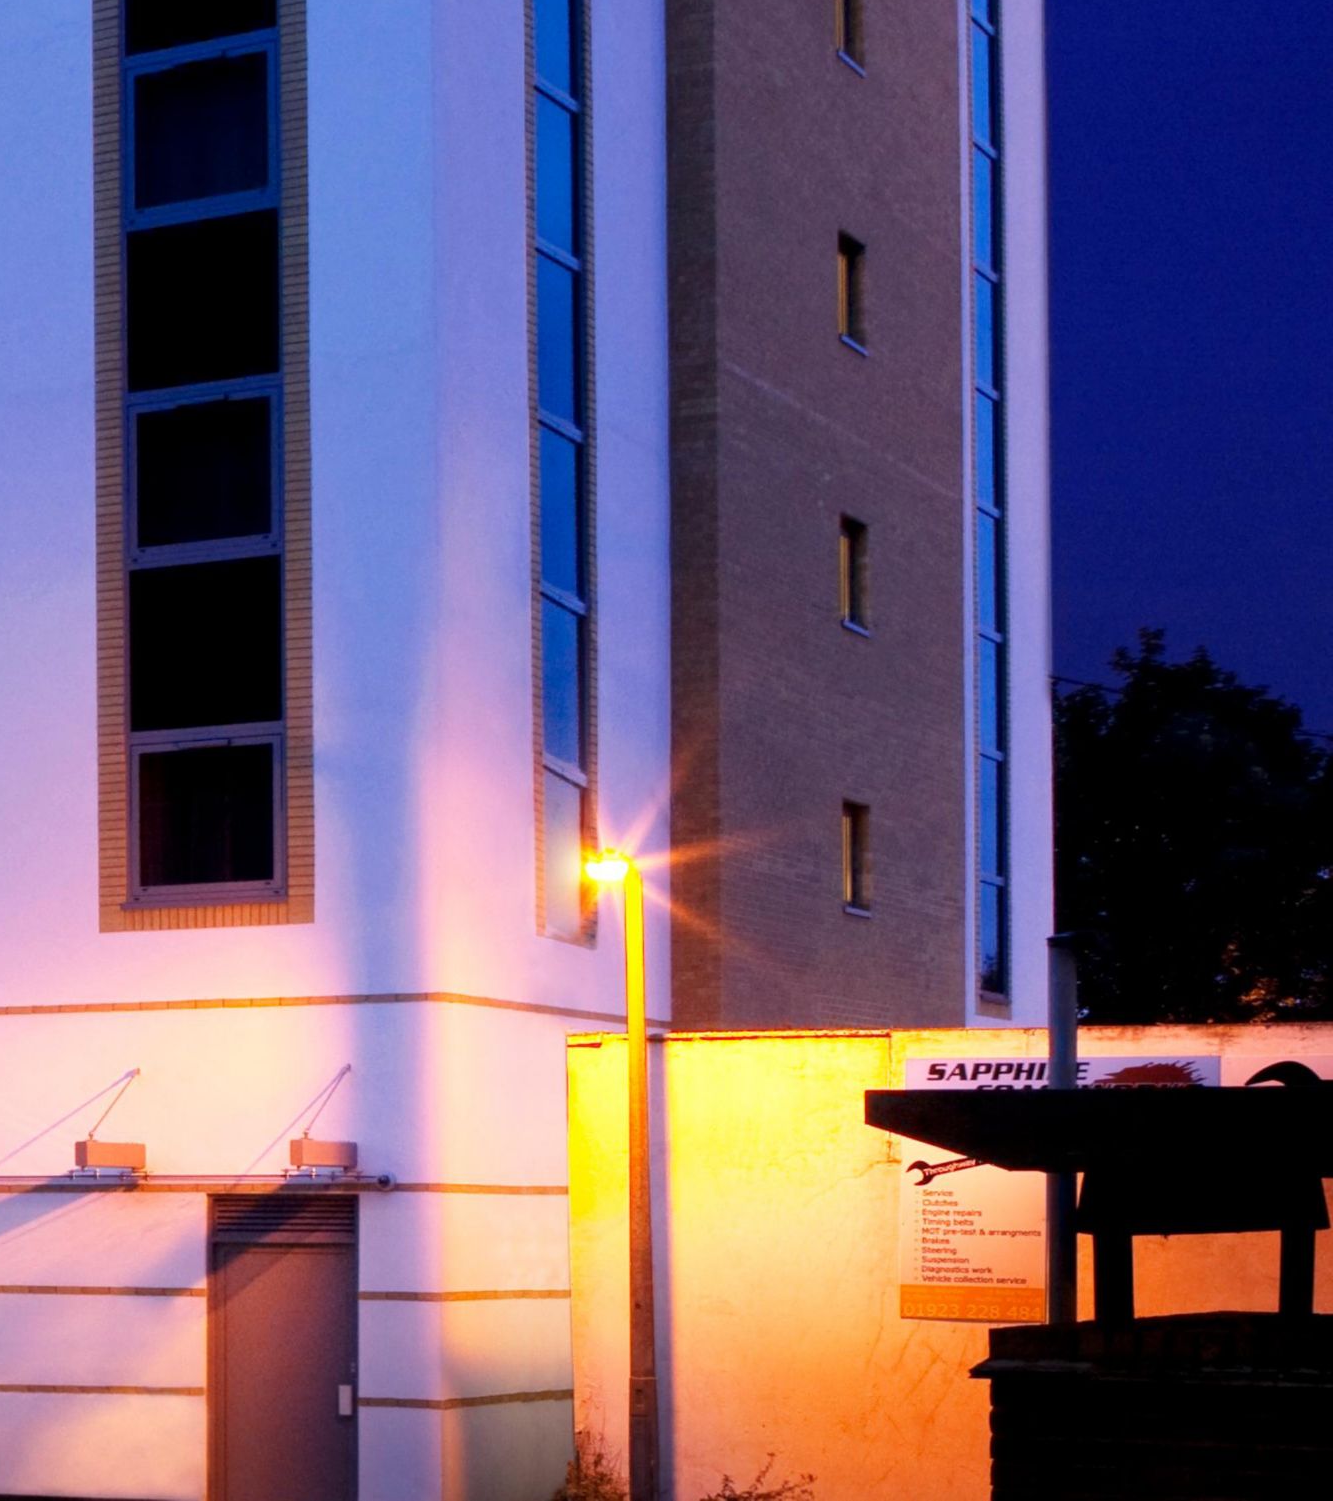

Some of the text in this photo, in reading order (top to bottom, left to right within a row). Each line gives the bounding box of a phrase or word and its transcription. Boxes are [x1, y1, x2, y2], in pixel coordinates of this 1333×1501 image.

[926, 1062, 1090, 1081] SAPPHIE
[922, 1189, 954, 1197] Service
[922, 1199, 958, 1207] Clutches
[922, 1209, 982, 1217] Engine repairs
[922, 1218, 974, 1226] Timing belts
[922, 1227, 941, 1235] MOT
[943, 1228, 976, 1236] pre-test
[921, 1247, 957, 1255] Steering
[921, 1256, 969, 1264] Suspension
[921, 1266, 969, 1274] Diagnostics
[954, 1276, 994, 1284] collection
[996, 1277, 1027, 1285] service
[904, 1302, 1042, 1321] 01923 228 484
